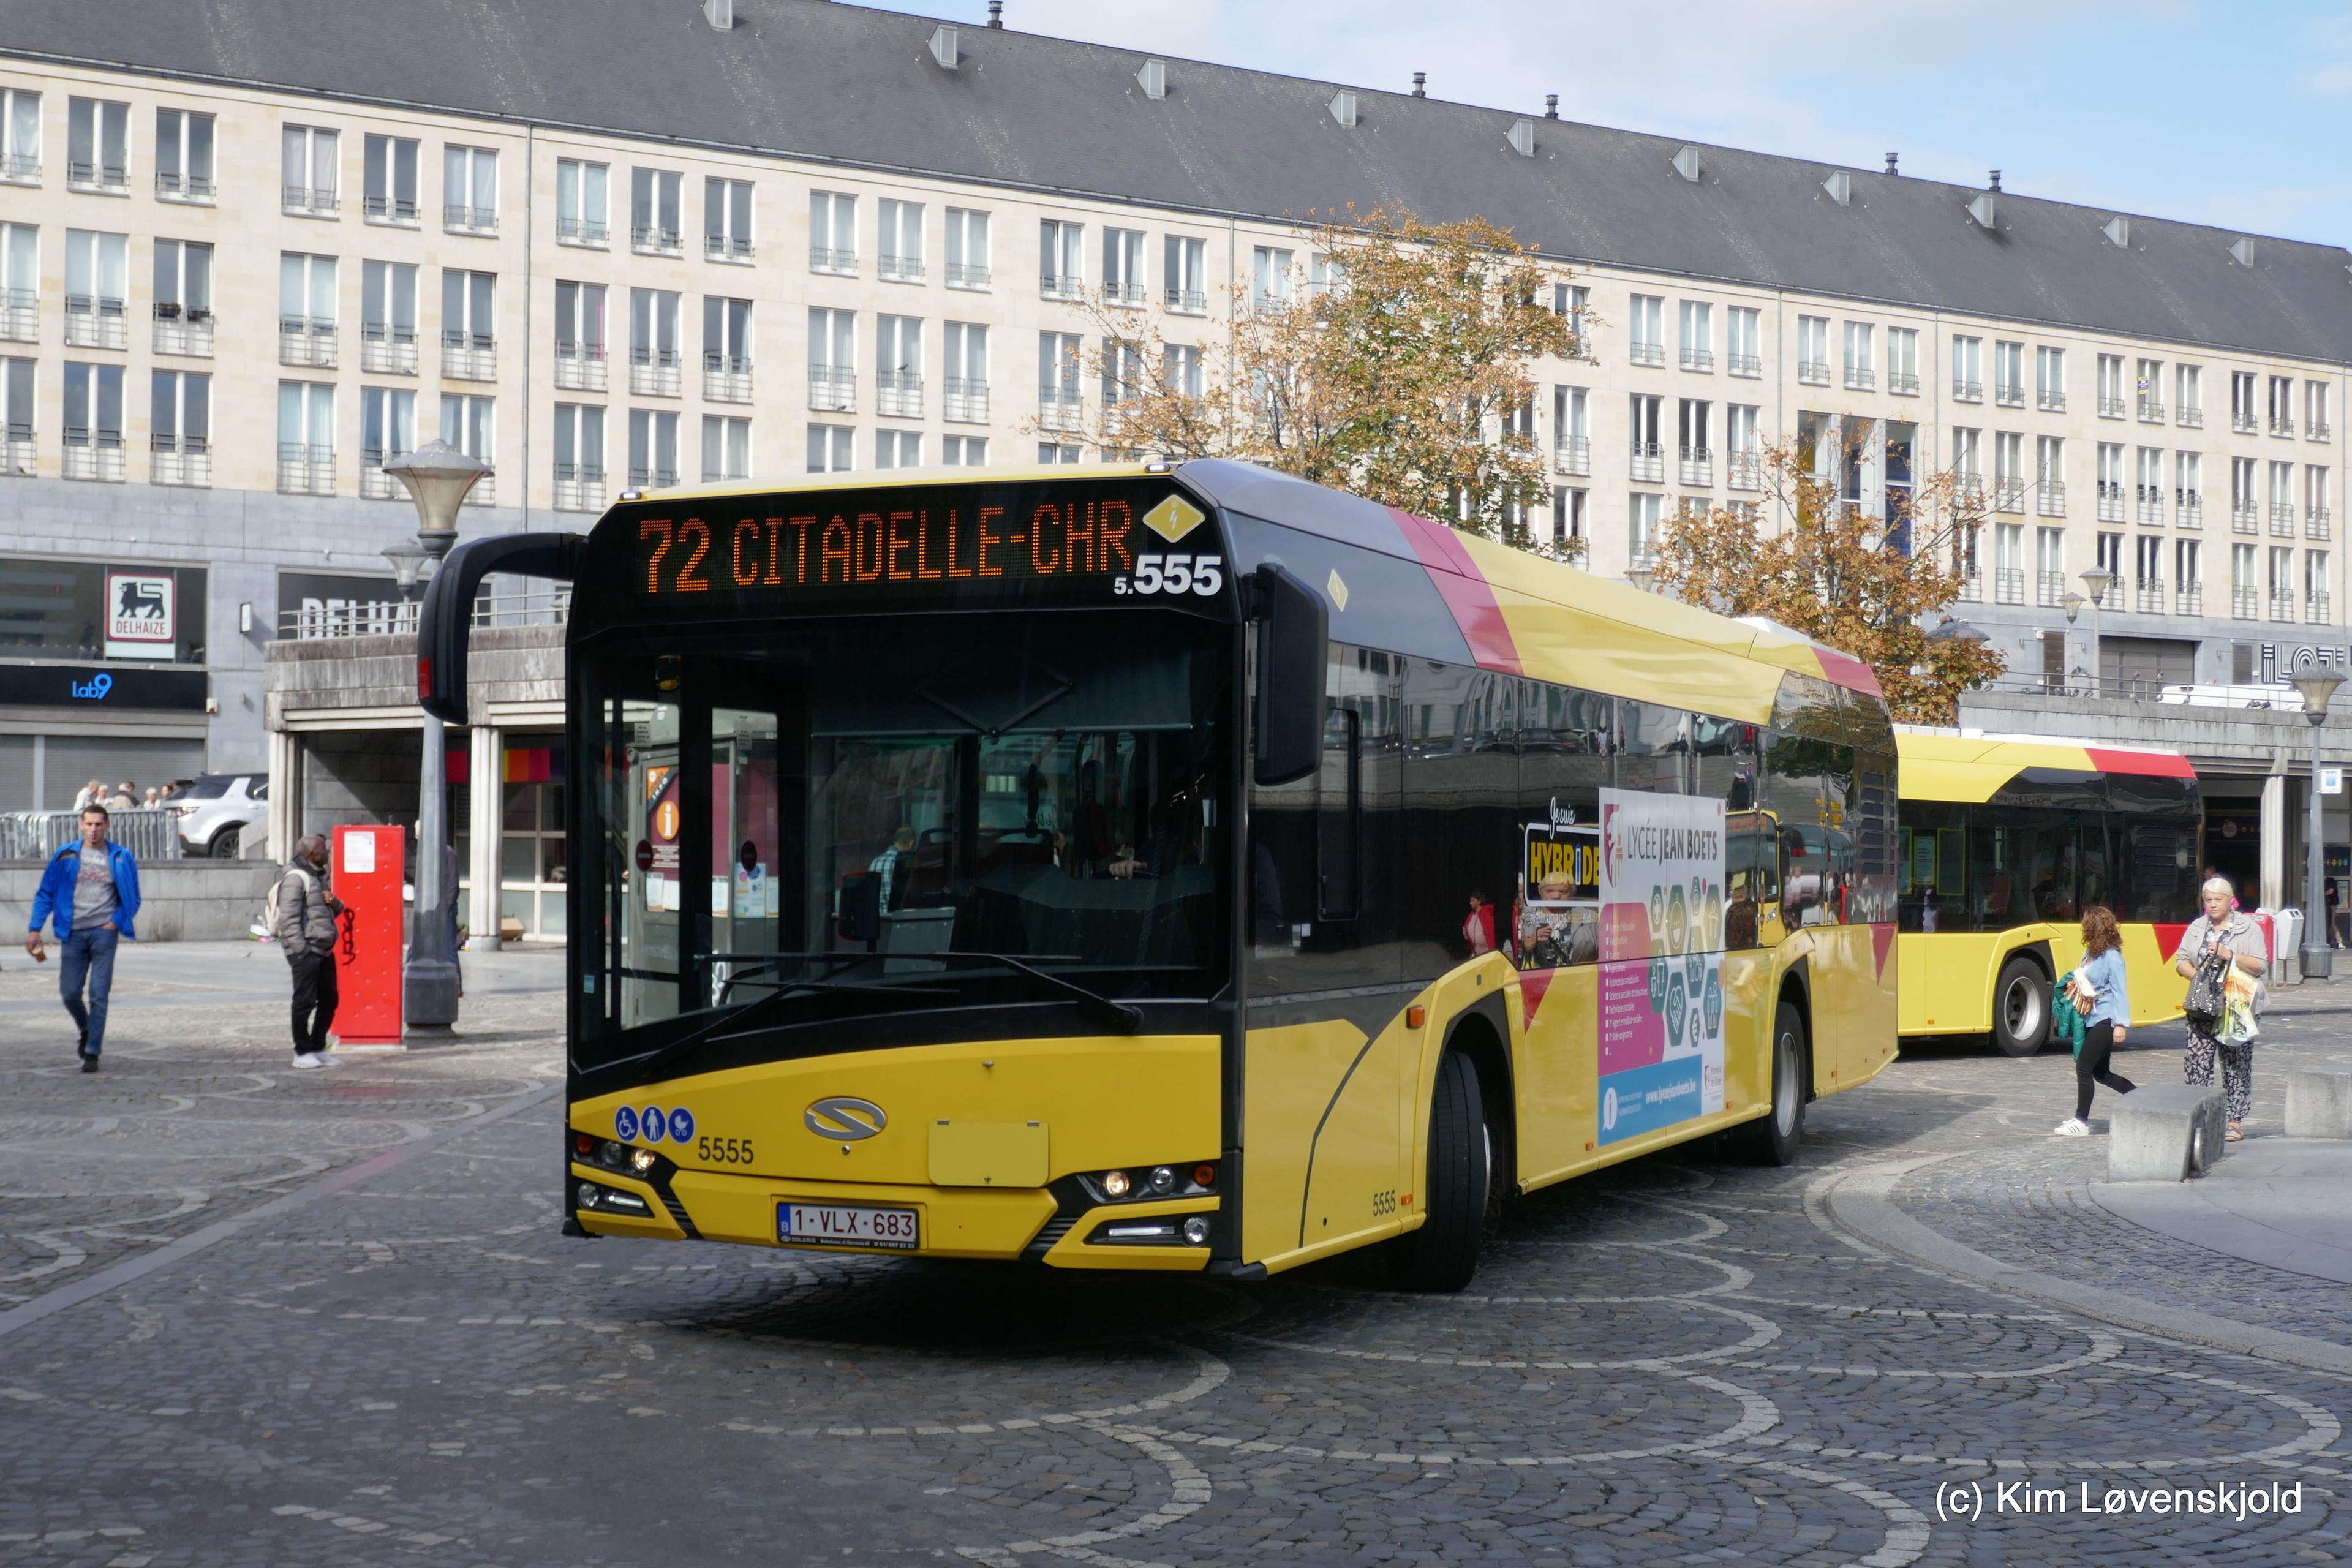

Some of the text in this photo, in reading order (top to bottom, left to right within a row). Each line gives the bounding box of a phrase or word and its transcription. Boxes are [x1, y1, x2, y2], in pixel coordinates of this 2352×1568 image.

[640, 501, 1131, 593] 72 CITADELLE-CHR
[116, 620, 165, 635] DELHAIZE
[73, 673, 113, 699] Lab9
[1628, 818, 1717, 867] LYCÉE JEAN BOETS
[1609, 992, 1621, 1001] Sciences
[1645, 1079, 1696, 1105] www.lyceejeanboets.be
[698, 1136, 754, 1165] 5555
[1373, 1189, 1396, 1217] 5555
[781, 1221, 789, 1232] B
